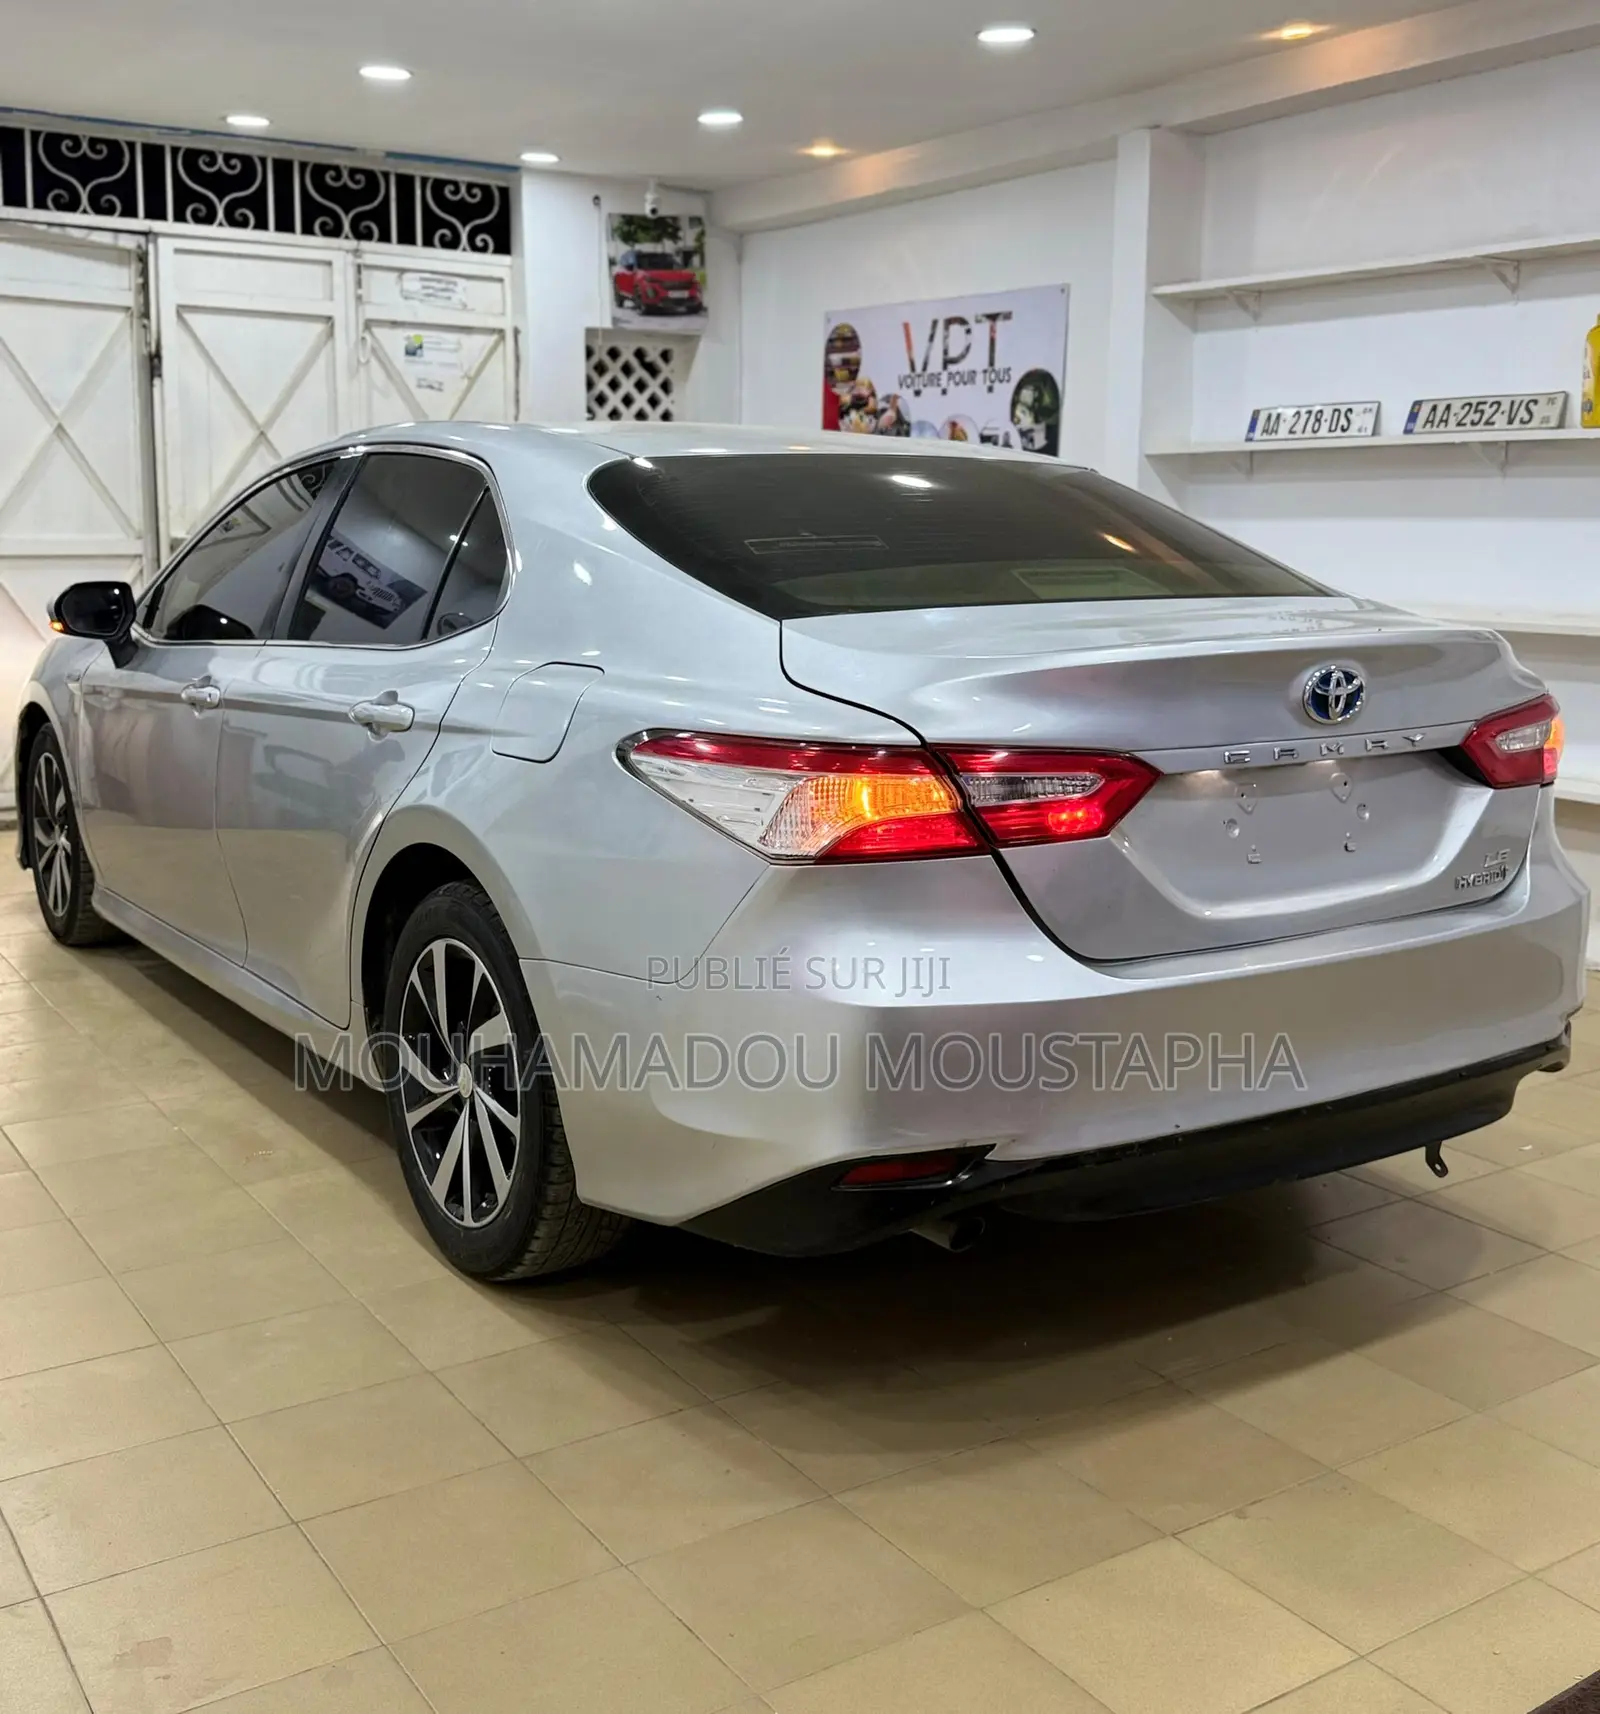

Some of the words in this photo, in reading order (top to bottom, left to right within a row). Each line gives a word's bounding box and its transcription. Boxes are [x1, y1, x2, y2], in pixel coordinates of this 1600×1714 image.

[898, 371, 942, 390] VOITURE
[946, 369, 977, 387] POUR
[982, 366, 1012, 385] TOUS
[902, 311, 1013, 397] VPT
